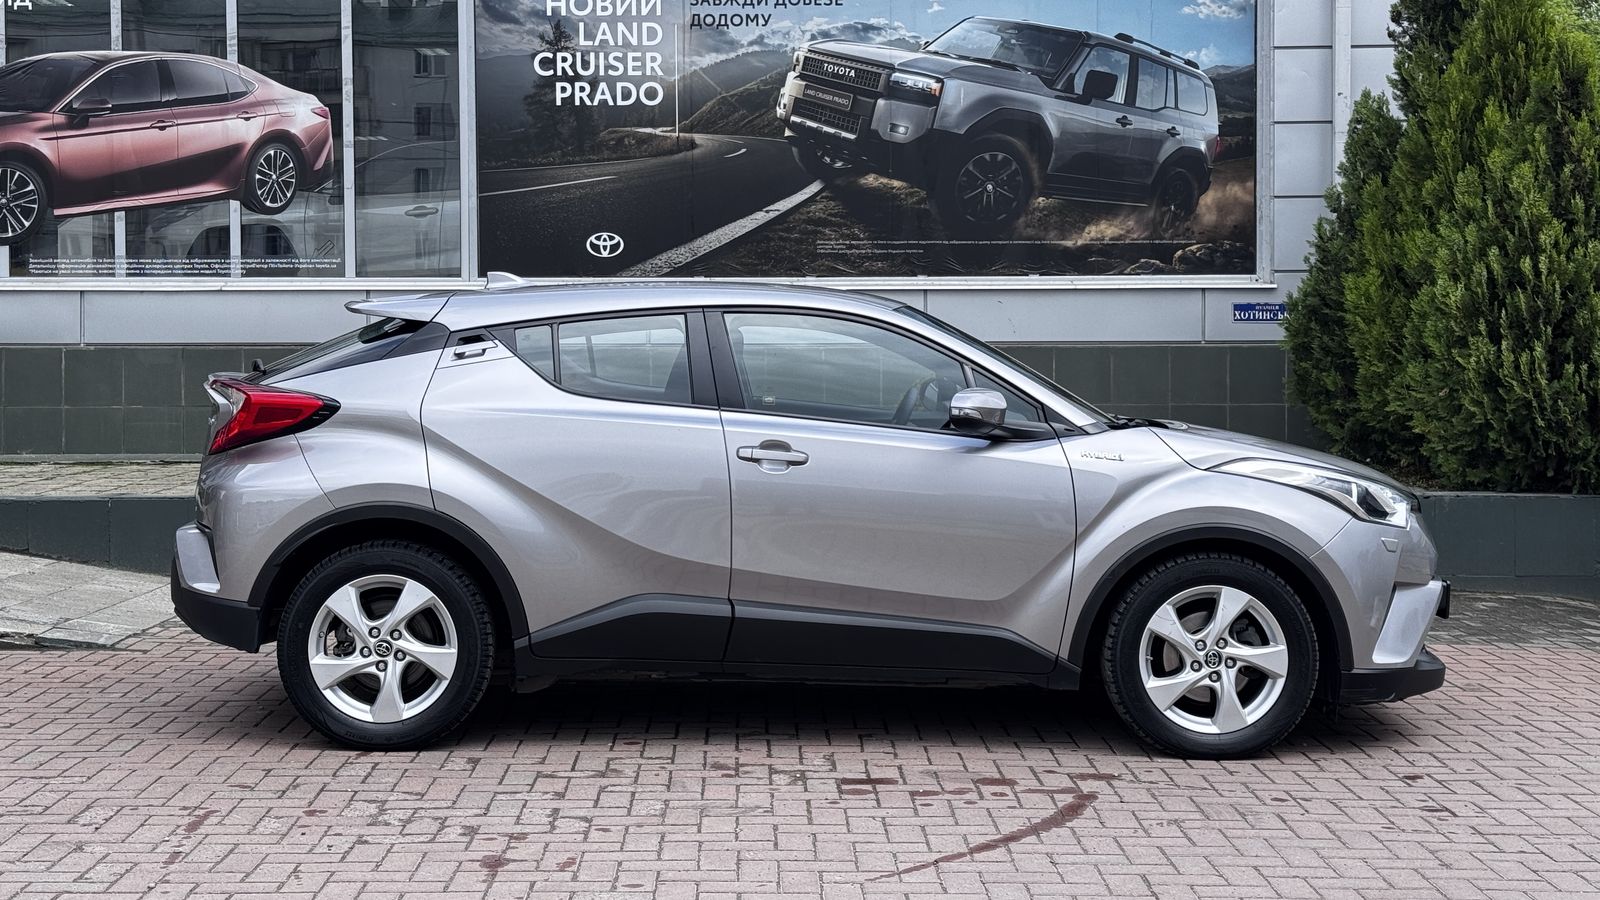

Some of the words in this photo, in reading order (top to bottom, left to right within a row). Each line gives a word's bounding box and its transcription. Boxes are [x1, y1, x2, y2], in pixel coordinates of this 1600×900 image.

[690, 13, 772, 30] ДОДОМУ
[579, 22, 663, 46] LAND
[533, 52, 664, 76] CRUISER
[823, 63, 856, 77] TOYOTA
[555, 82, 664, 106] PRADO
[804, 88, 816, 96] LAND
[816, 91, 833, 101] CRUISER
[833, 96, 849, 105] PRADO
